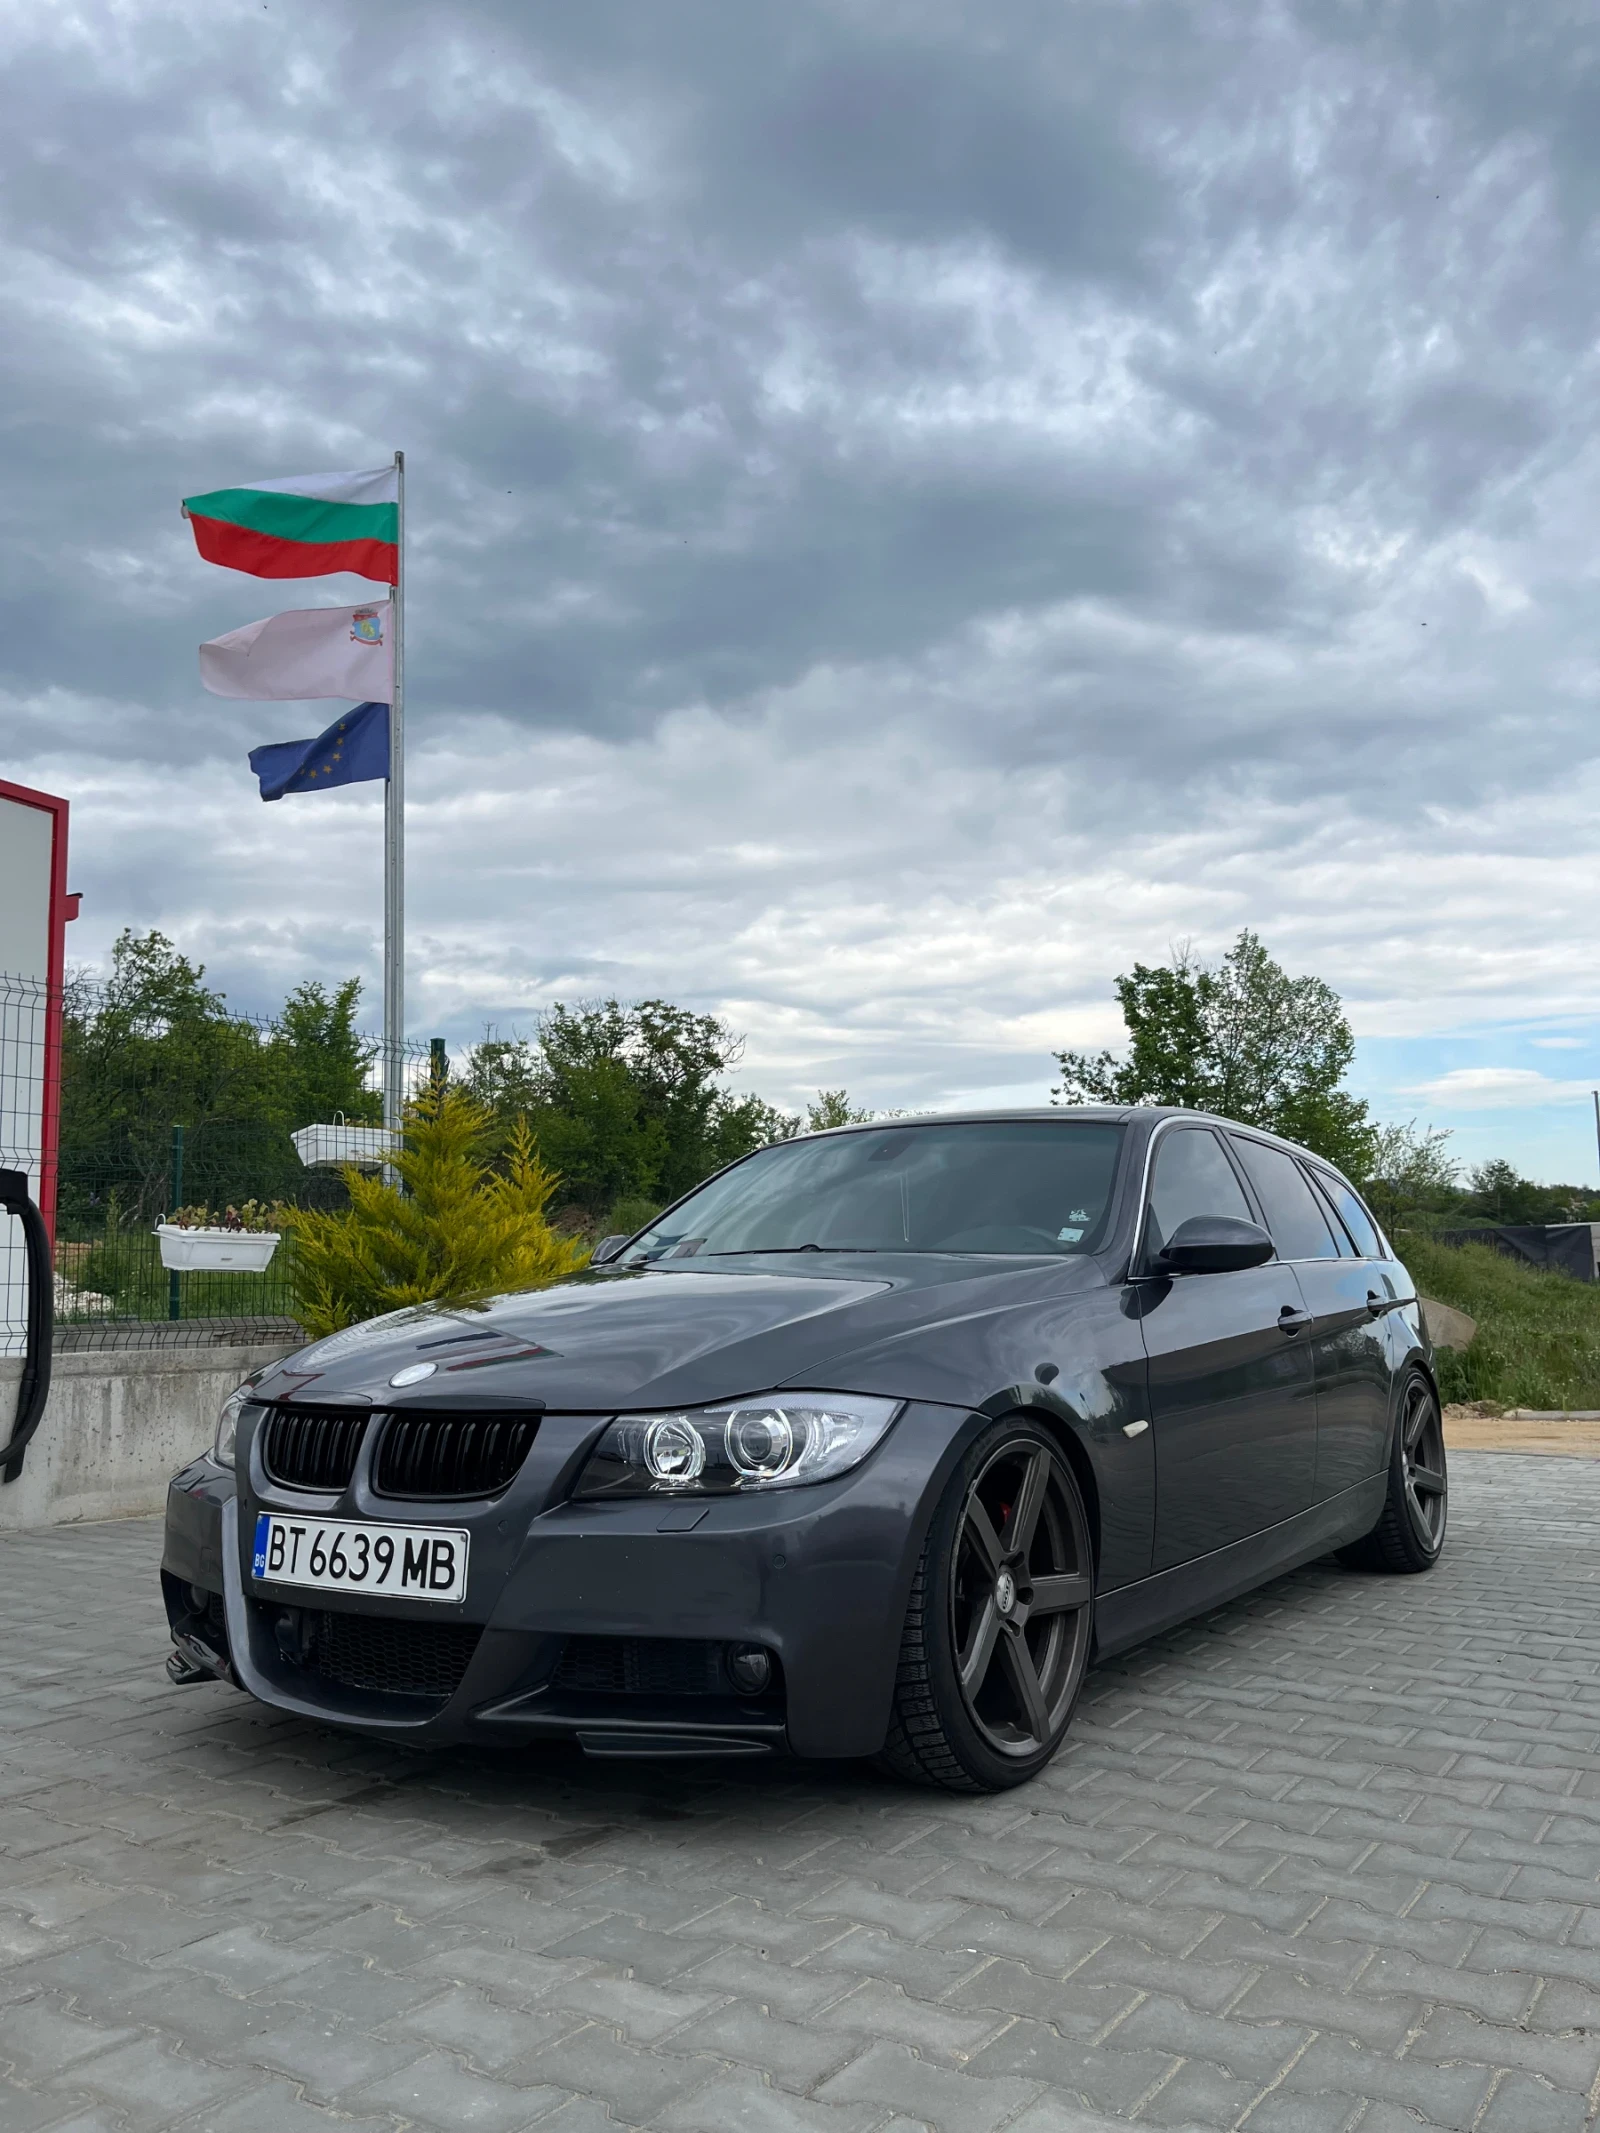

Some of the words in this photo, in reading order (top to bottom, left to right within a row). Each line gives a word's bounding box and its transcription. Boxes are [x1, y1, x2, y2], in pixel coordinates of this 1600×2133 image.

[254, 1553, 265, 1568] BG
[268, 1524, 307, 1574] BT
[309, 1529, 395, 1584] 6639
[401, 1537, 456, 1590] MB
